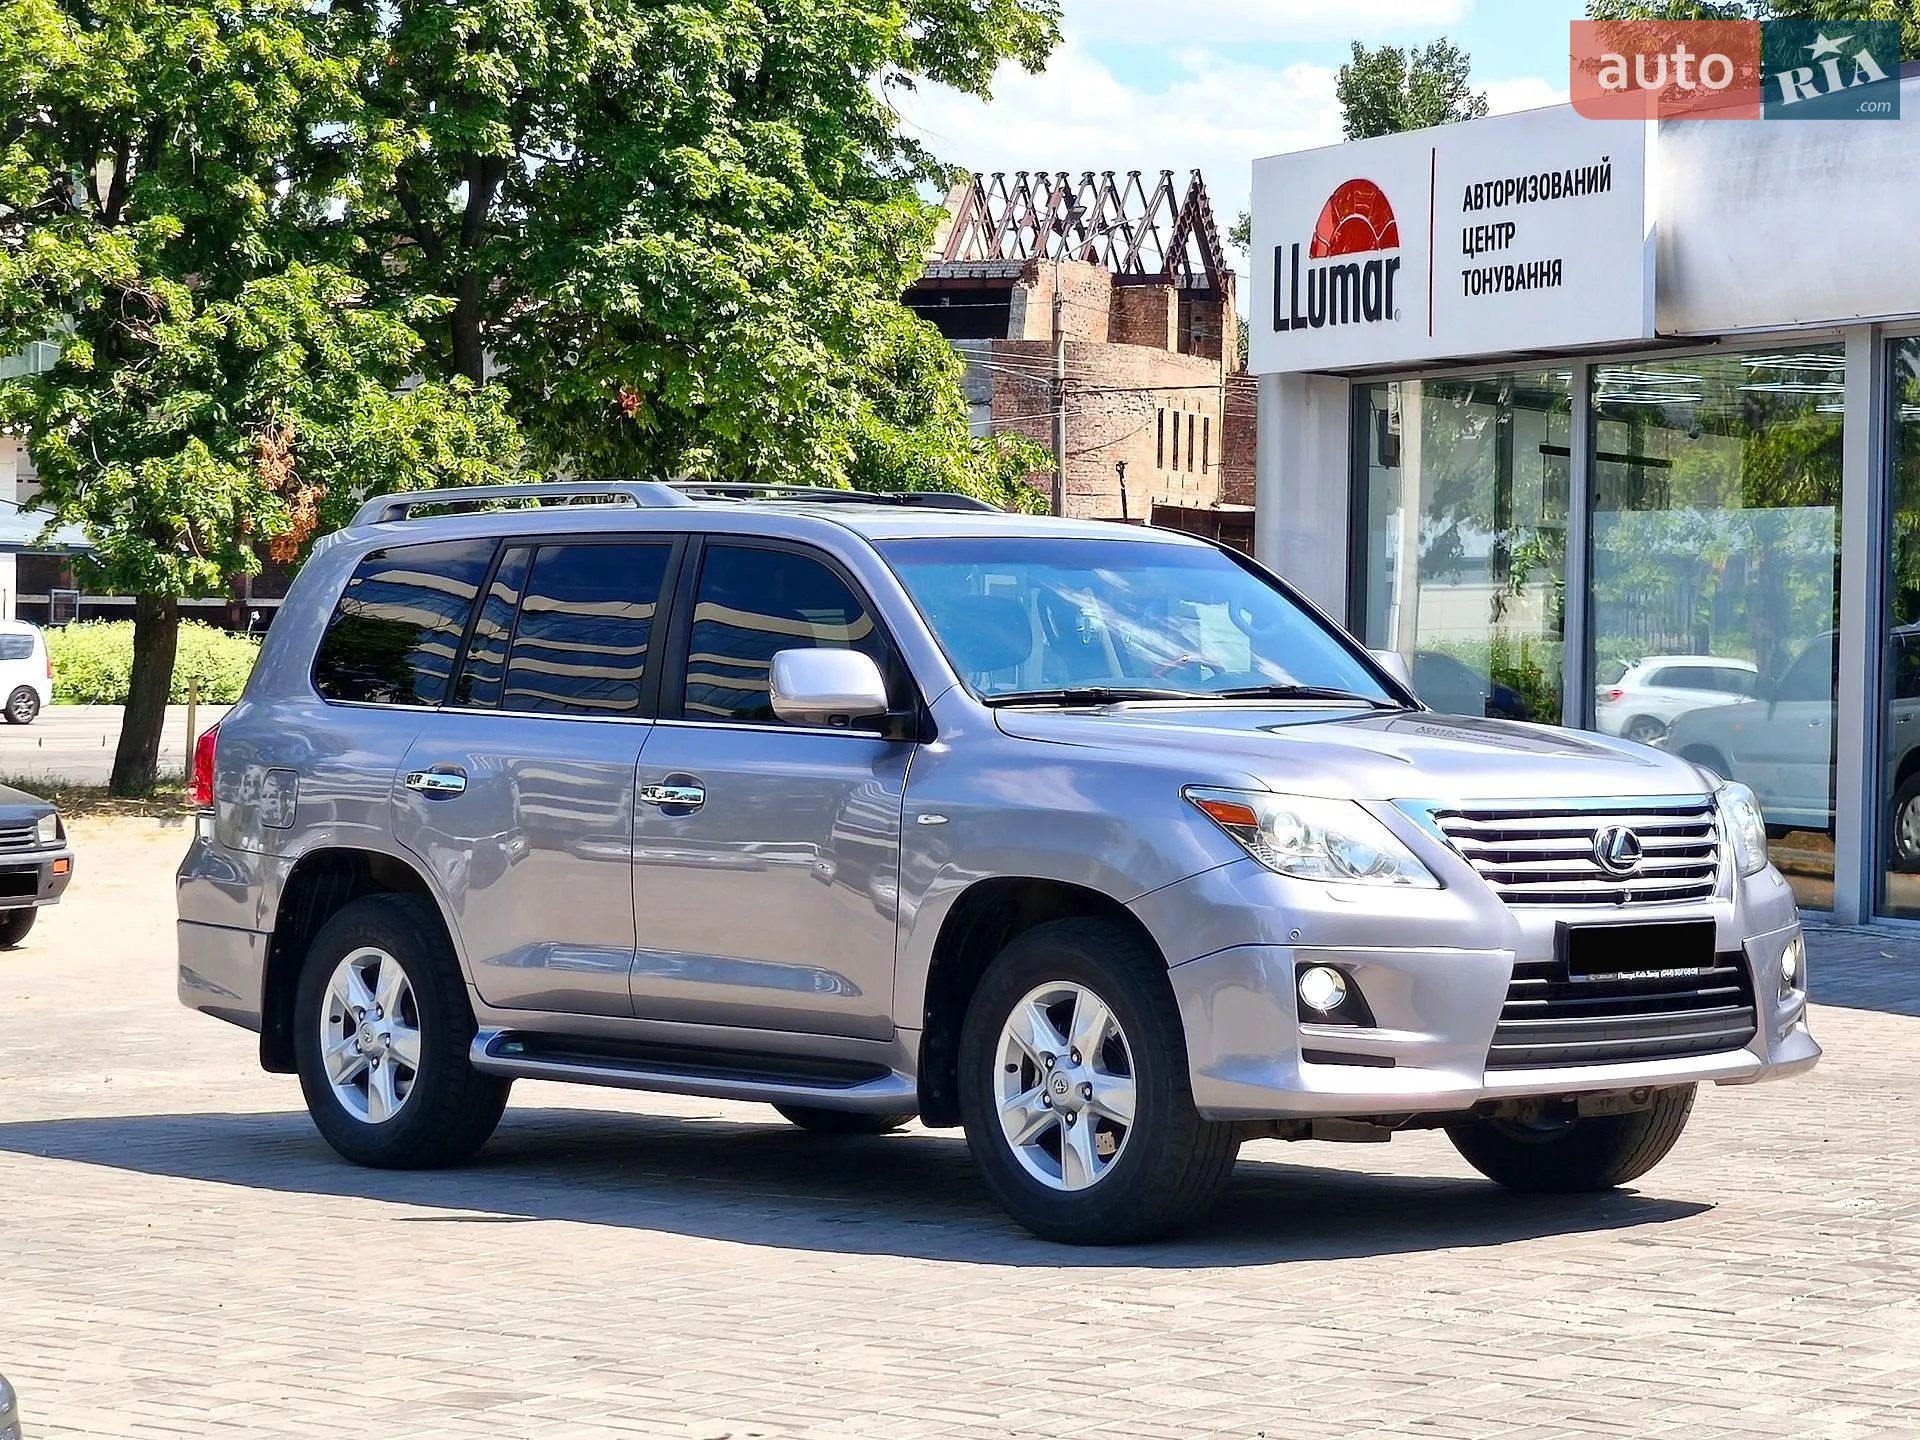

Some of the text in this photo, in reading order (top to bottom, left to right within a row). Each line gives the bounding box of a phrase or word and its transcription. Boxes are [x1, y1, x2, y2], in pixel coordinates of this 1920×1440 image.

[1462, 155, 1612, 212] АВТОРИЗОВАНИЙ
[1462, 221, 1516, 259] ЦЕНТР
[1273, 243, 1400, 332] LLumar
[1461, 258, 1562, 297] ТОНУВАННЯ
